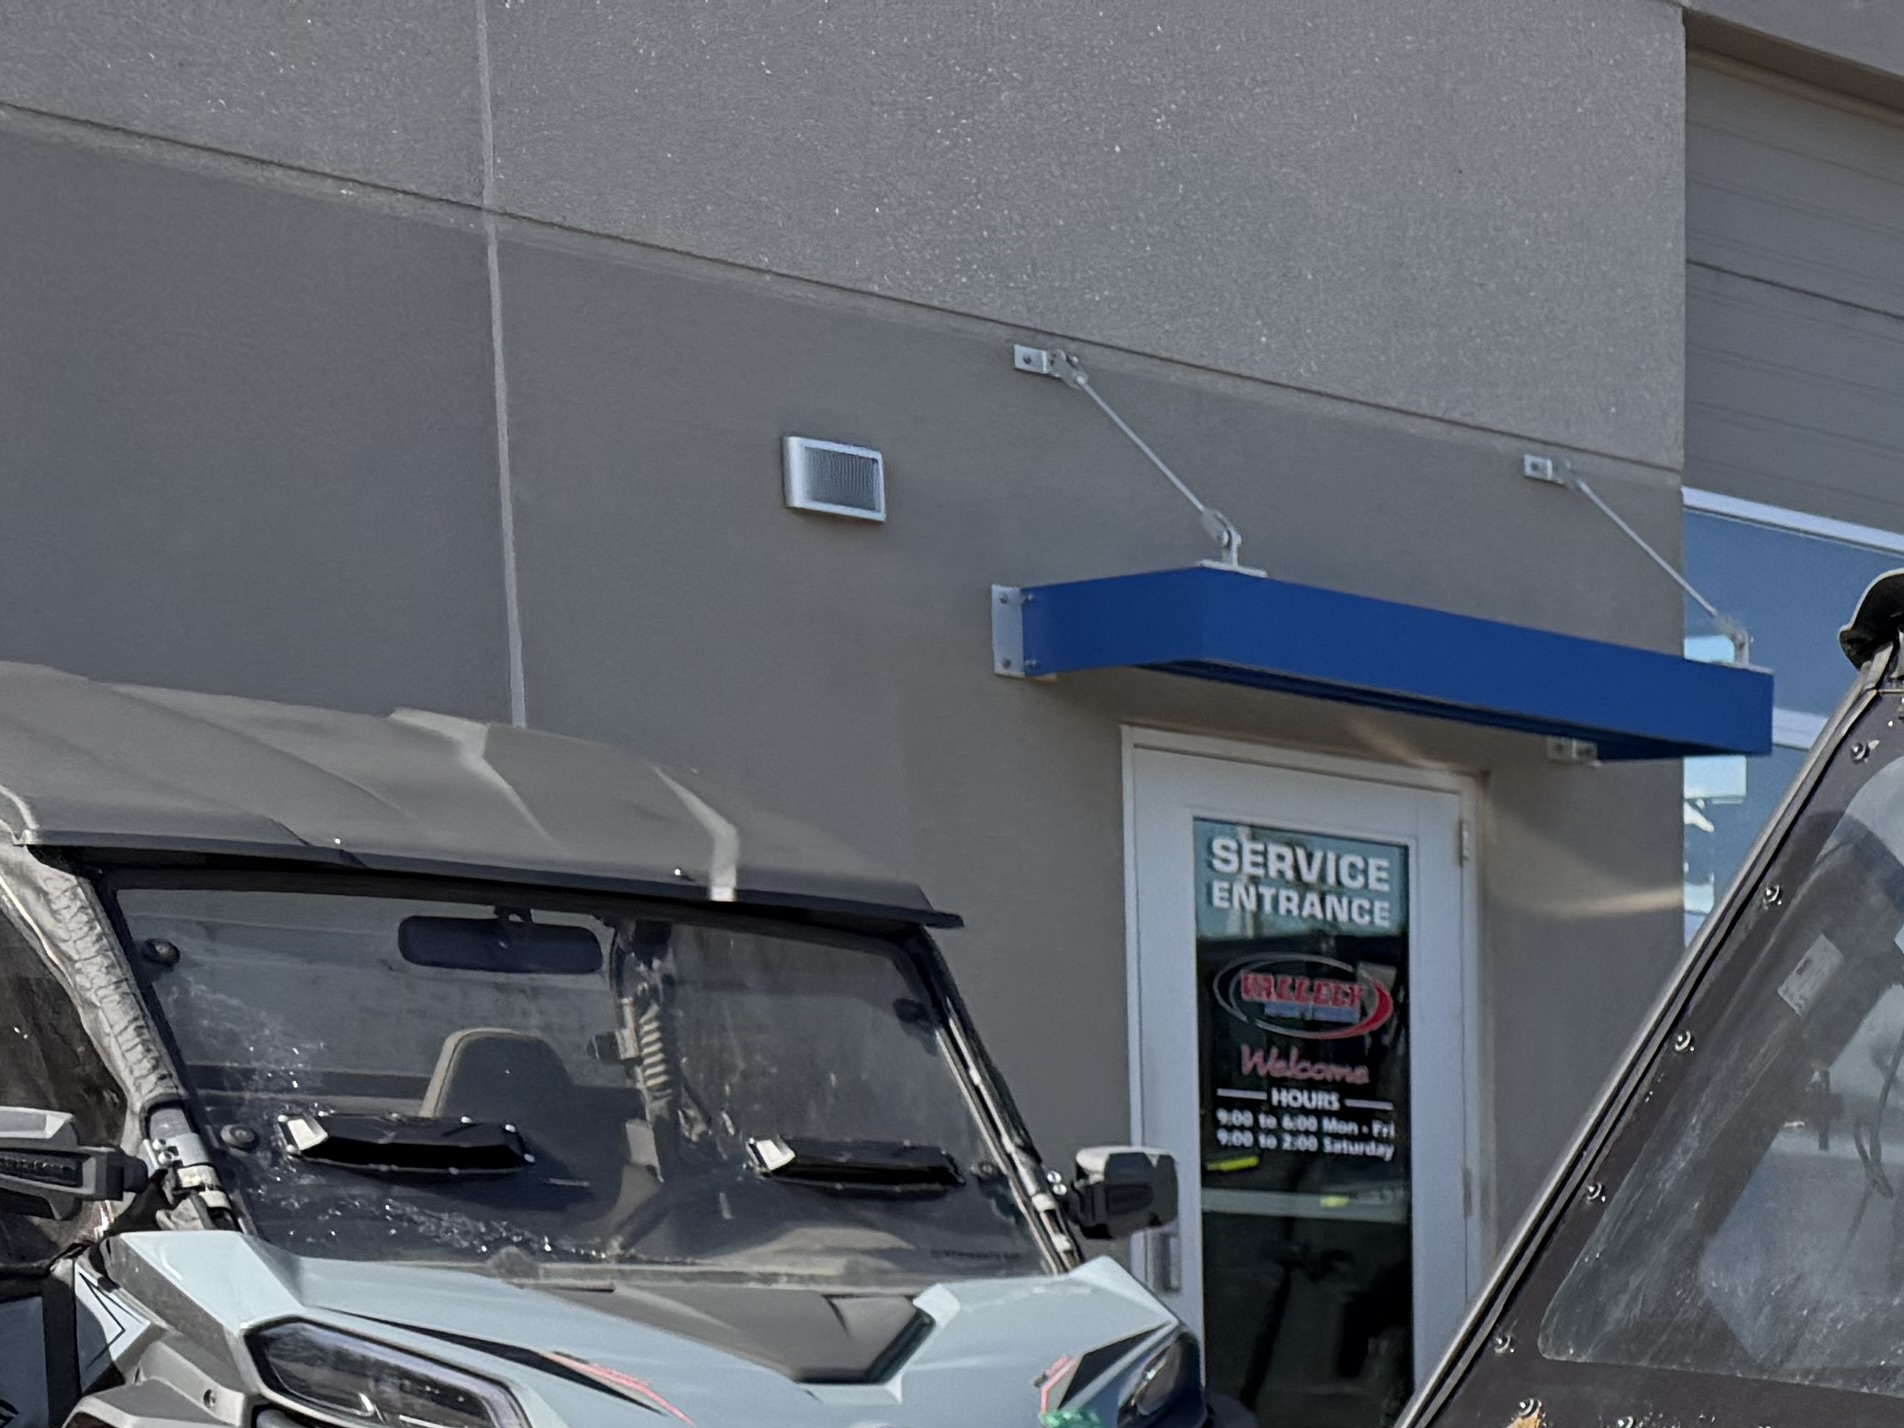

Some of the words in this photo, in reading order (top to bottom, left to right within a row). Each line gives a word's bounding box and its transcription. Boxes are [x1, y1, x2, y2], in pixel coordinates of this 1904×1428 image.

[1211, 837, 1390, 892] SERVICE
[1211, 879, 1391, 928] ENTRANCE
[1240, 1043, 1370, 1085] Welcome
[1271, 1087, 1340, 1110] HOURS
[1258, 1112, 1278, 1129] to
[1322, 1116, 1359, 1136] Mon
[1371, 1119, 1395, 1139] Fri
[1258, 1132, 1278, 1149] to
[1322, 1136, 1395, 1162] Saturday
